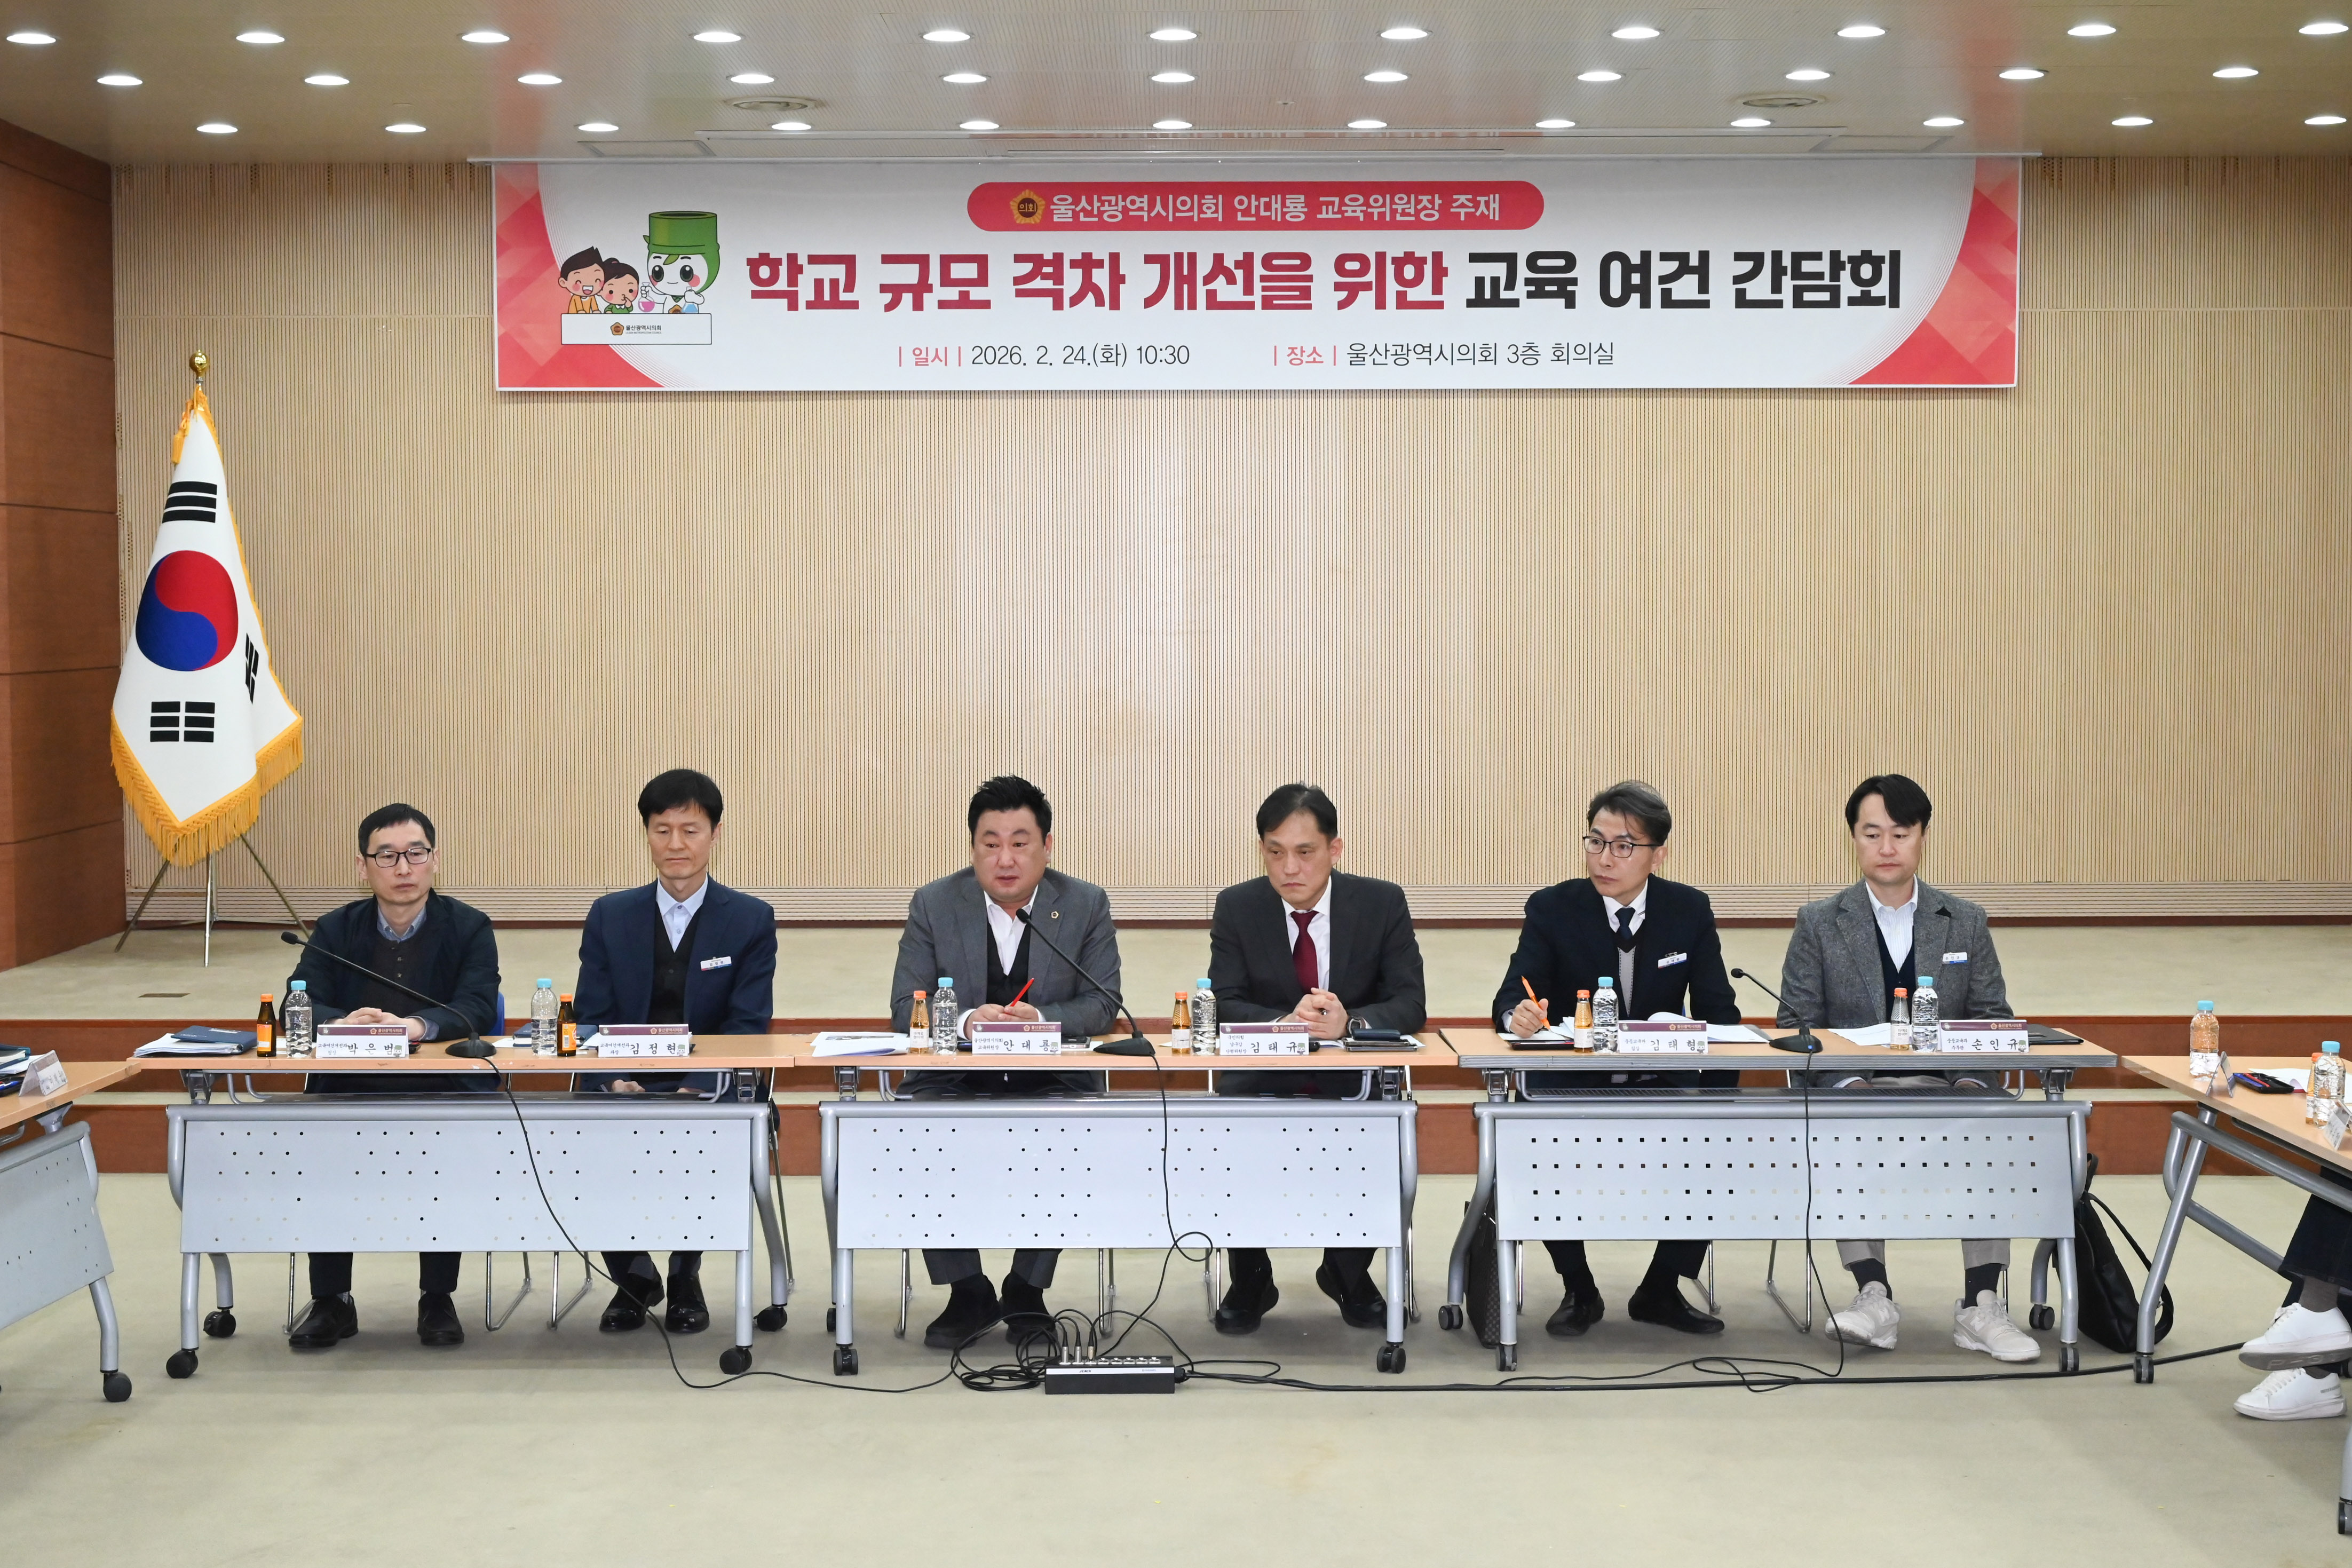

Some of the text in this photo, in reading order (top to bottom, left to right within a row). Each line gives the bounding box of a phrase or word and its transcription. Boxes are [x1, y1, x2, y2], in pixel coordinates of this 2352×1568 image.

[1018, 202, 1036, 212] 의회
[1050, 193, 1500, 223] 울산광역시의회 안대룡 교육위원장 주재
[746, 249, 1901, 312] 학교 규모 격차 개선을 위한 교육 여건 간담회
[912, 342, 1190, 368] 일시 2026. 2. 24.(화) 10:30
[1286, 342, 1614, 367] 장소 울산광역시의회 3층 회의실
[347, 1043, 393, 1055] 박 은 범
[630, 1043, 676, 1055] 김 정 현
[1004, 1040, 1050, 1051] 안 대 룡
[1251, 1042, 1297, 1054] 김 태 규
[1651, 1039, 1696, 1051] 김 태 형
[1971, 1039, 2018, 1050] 손 인 규
